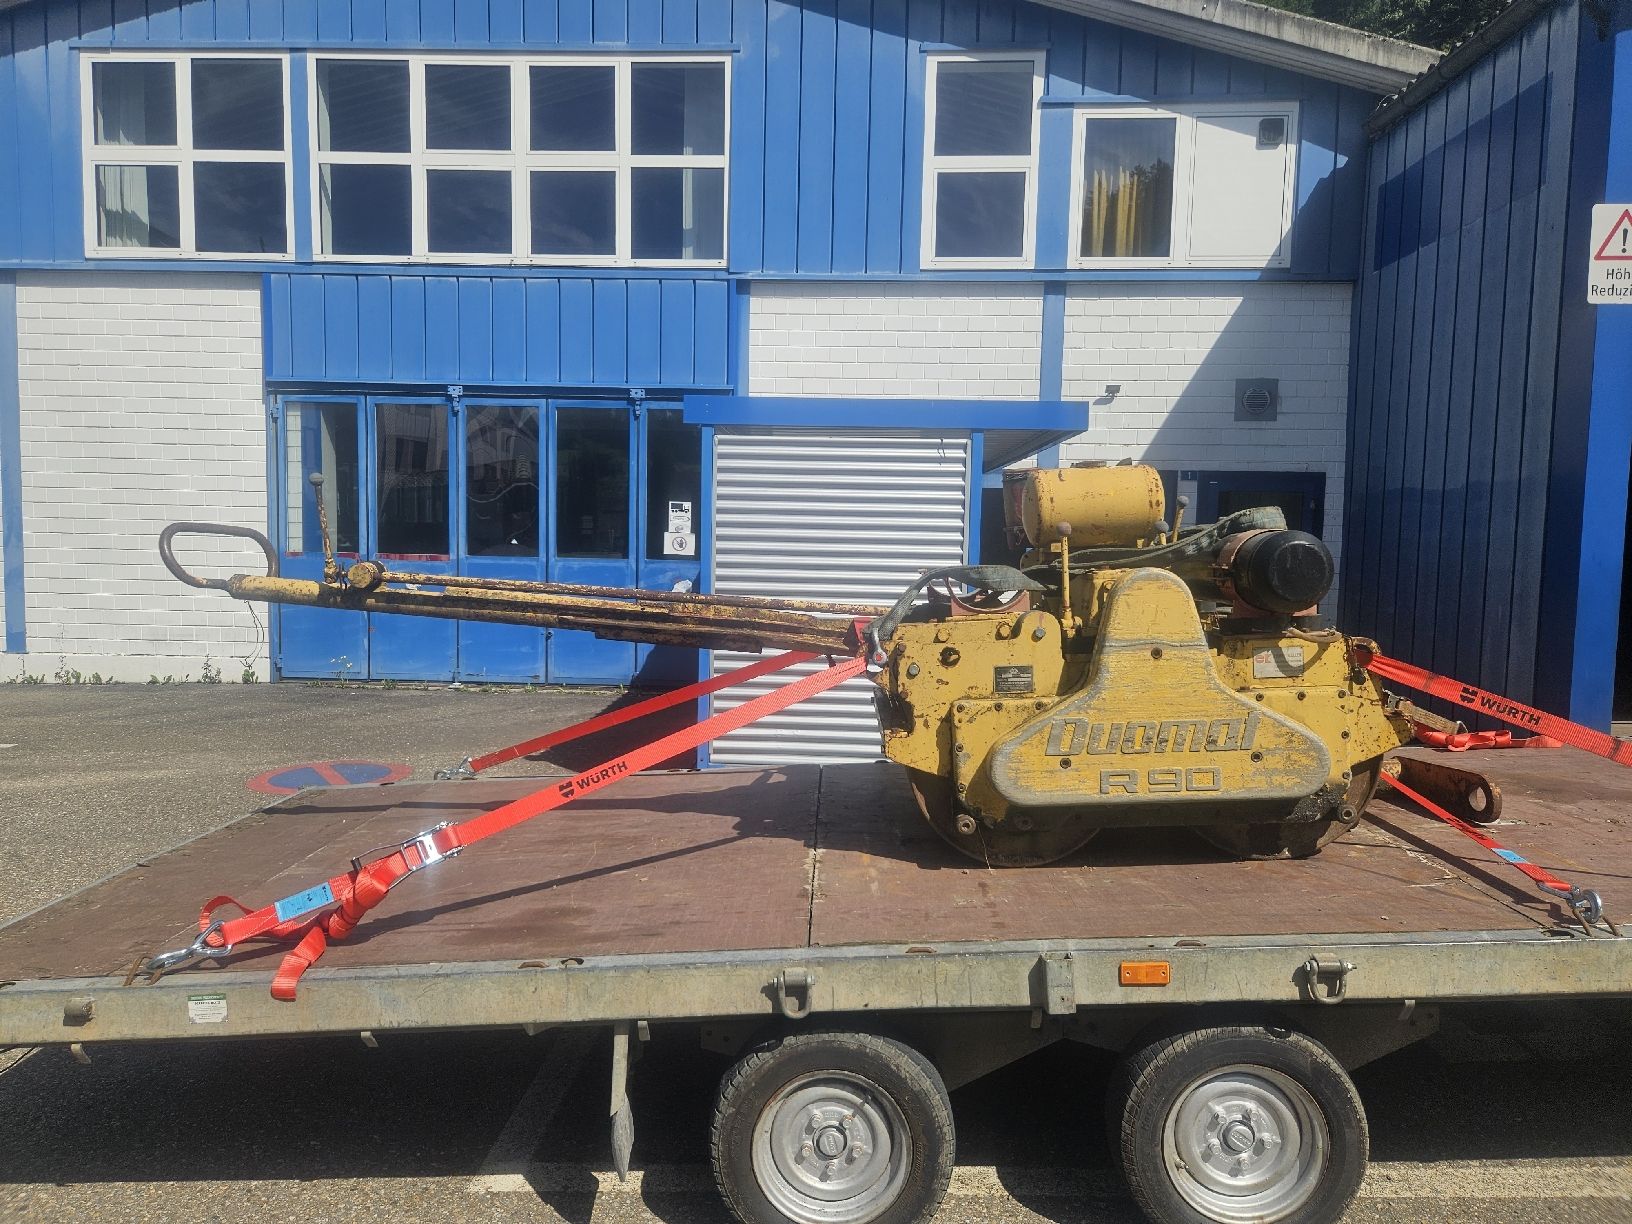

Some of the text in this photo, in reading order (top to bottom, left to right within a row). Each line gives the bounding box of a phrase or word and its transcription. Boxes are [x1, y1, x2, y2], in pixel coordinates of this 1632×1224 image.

[1480, 696, 1541, 726] WÜRTH
[1045, 711, 1260, 756] Duomat
[576, 761, 628, 789] WÜRTH
[1099, 766, 1222, 794] R 90
